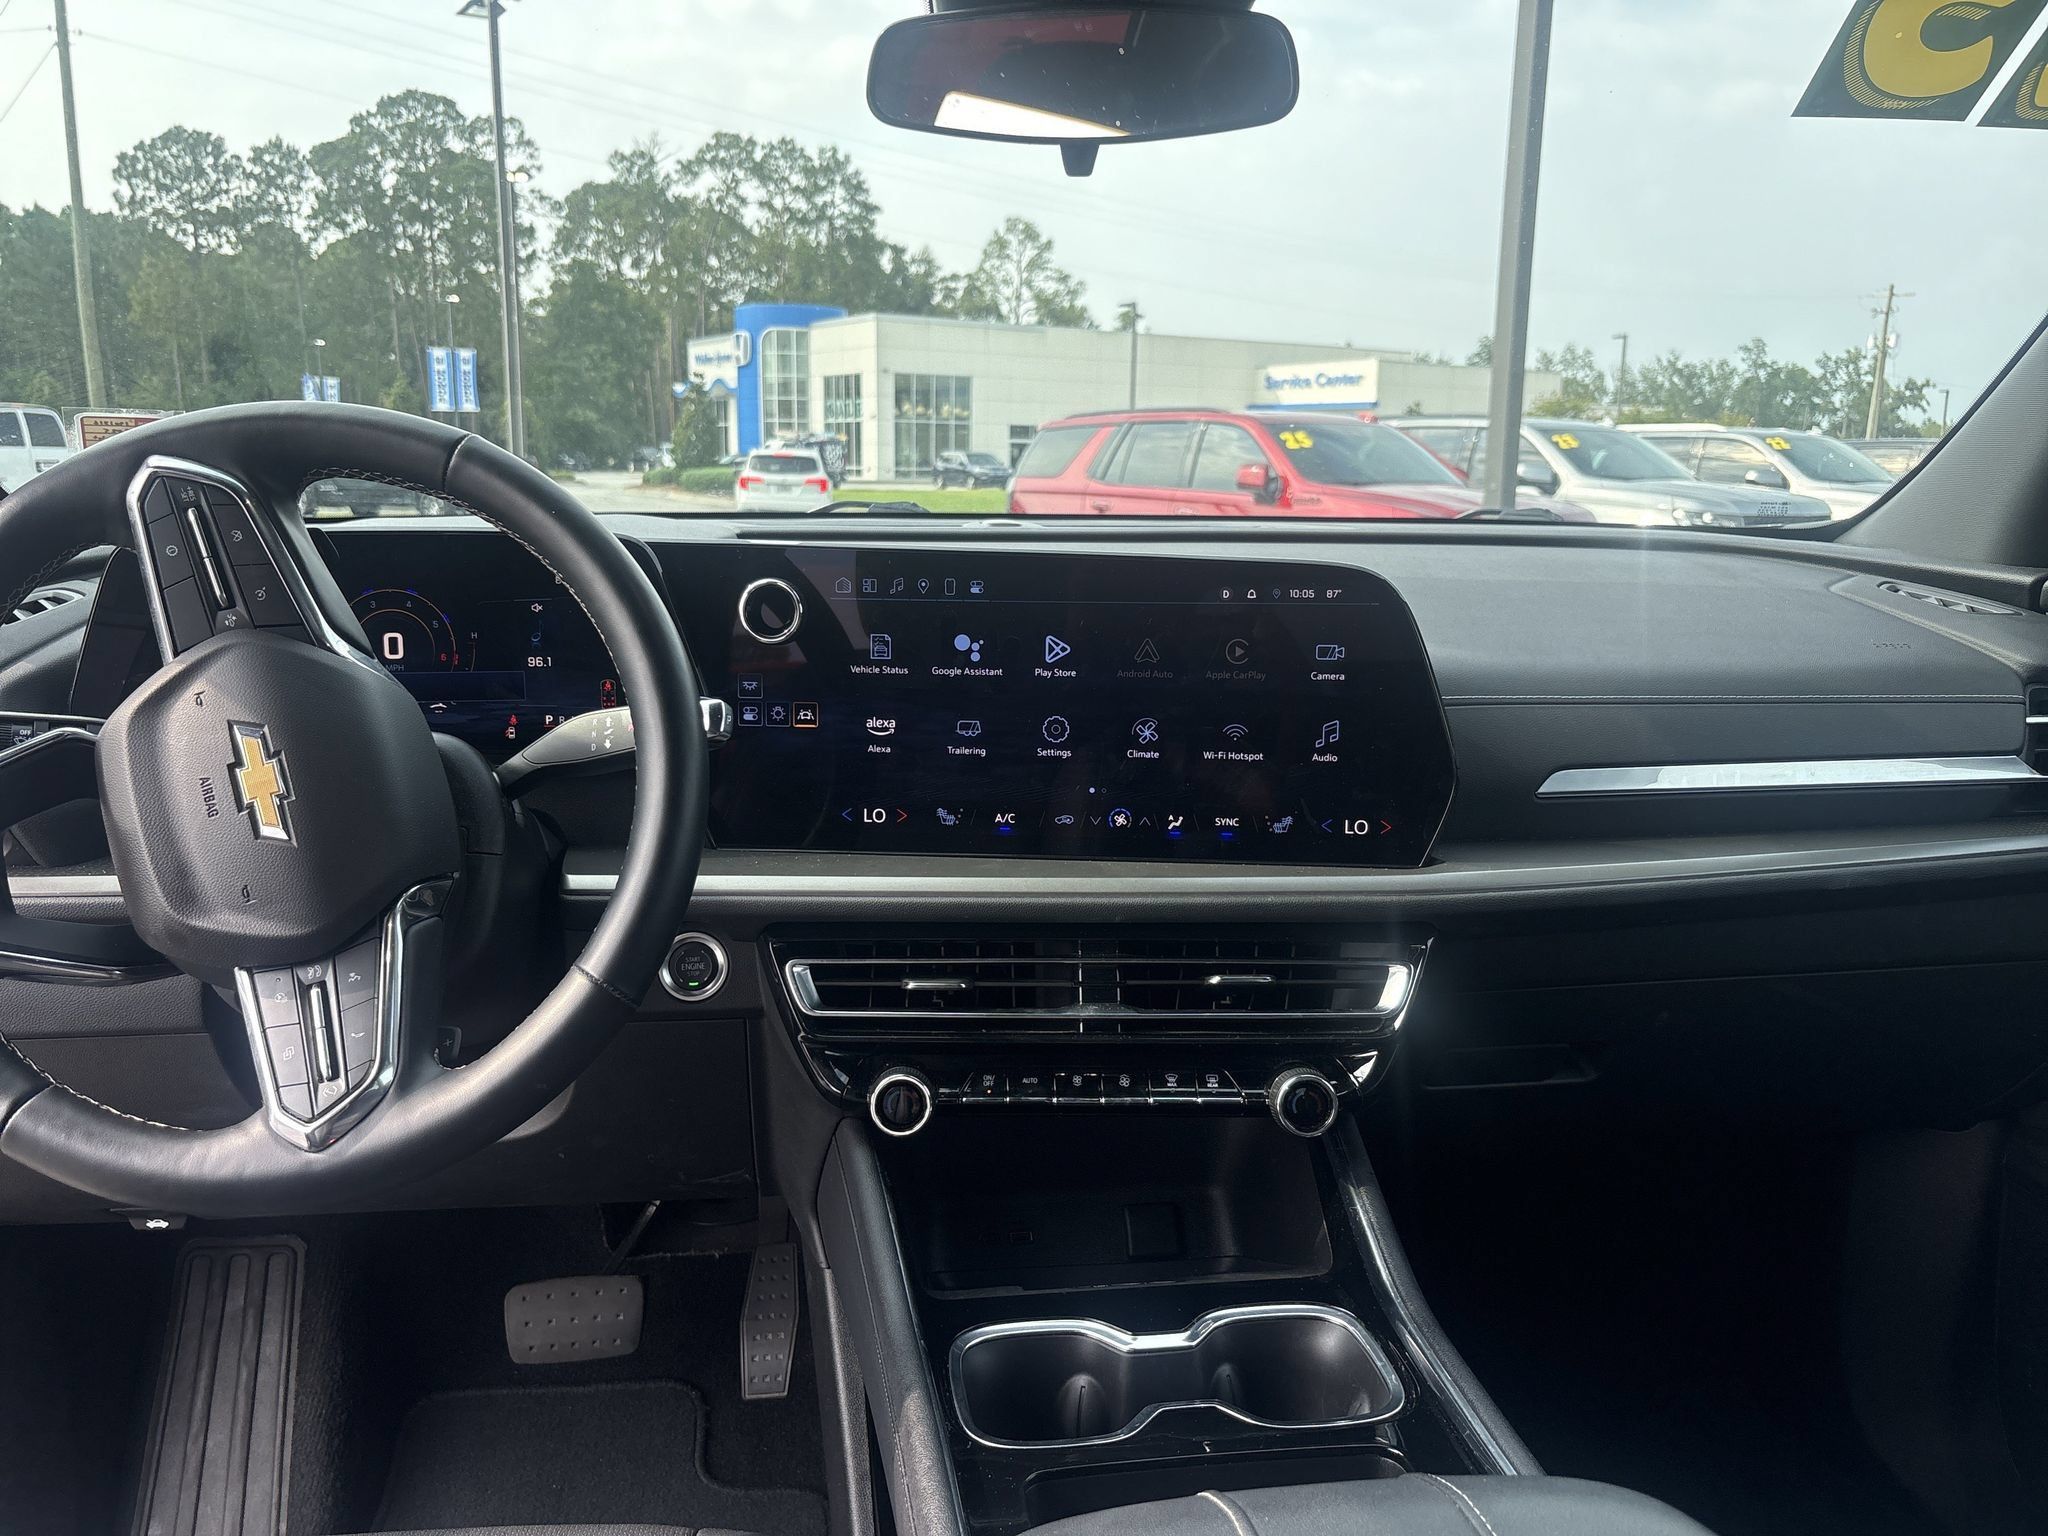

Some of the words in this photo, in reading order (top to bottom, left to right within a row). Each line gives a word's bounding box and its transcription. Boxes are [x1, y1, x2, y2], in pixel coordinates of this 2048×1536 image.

[1263, 375, 1312, 390] Service
[1316, 373, 1365, 387] Center
[1289, 589, 1315, 599] 10:05
[370, 601, 376, 609] 3
[406, 600, 412, 608] 4
[433, 620, 439, 629] 5
[383, 632, 405, 660] 0
[440, 653, 447, 661] 6
[527, 656, 552, 668] 96.1
[850, 665, 881, 675] Vehicle
[882, 665, 909, 675] Status
[931, 666, 962, 678] Google
[964, 667, 1004, 677] Assistant
[1034, 668, 1051, 679] Play
[1054, 668, 1077, 678] Store
[1117, 669, 1150, 678] Android
[1152, 670, 1174, 679] Auto
[1205, 670, 1231, 681] Apple
[1232, 670, 1267, 682] CarPlay
[1310, 671, 1346, 681] Camera
[545, 714, 554, 725] P
[866, 716, 896, 728] alexa
[867, 744, 891, 753] Alexa
[947, 746, 987, 758] Trailering
[1037, 748, 1072, 759] Settings
[1127, 749, 1160, 759] Climate
[1203, 751, 1227, 761] Wi-Fi
[1228, 751, 1264, 762] Hotspot
[1312, 753, 1338, 763] Audio
[198, 777, 220, 819] AIRBAG
[863, 808, 887, 823] LO
[994, 813, 1016, 824] A/C
[1215, 817, 1240, 827] SYNC
[1344, 819, 1369, 835] LO
[681, 962, 706, 971] ENGINE
